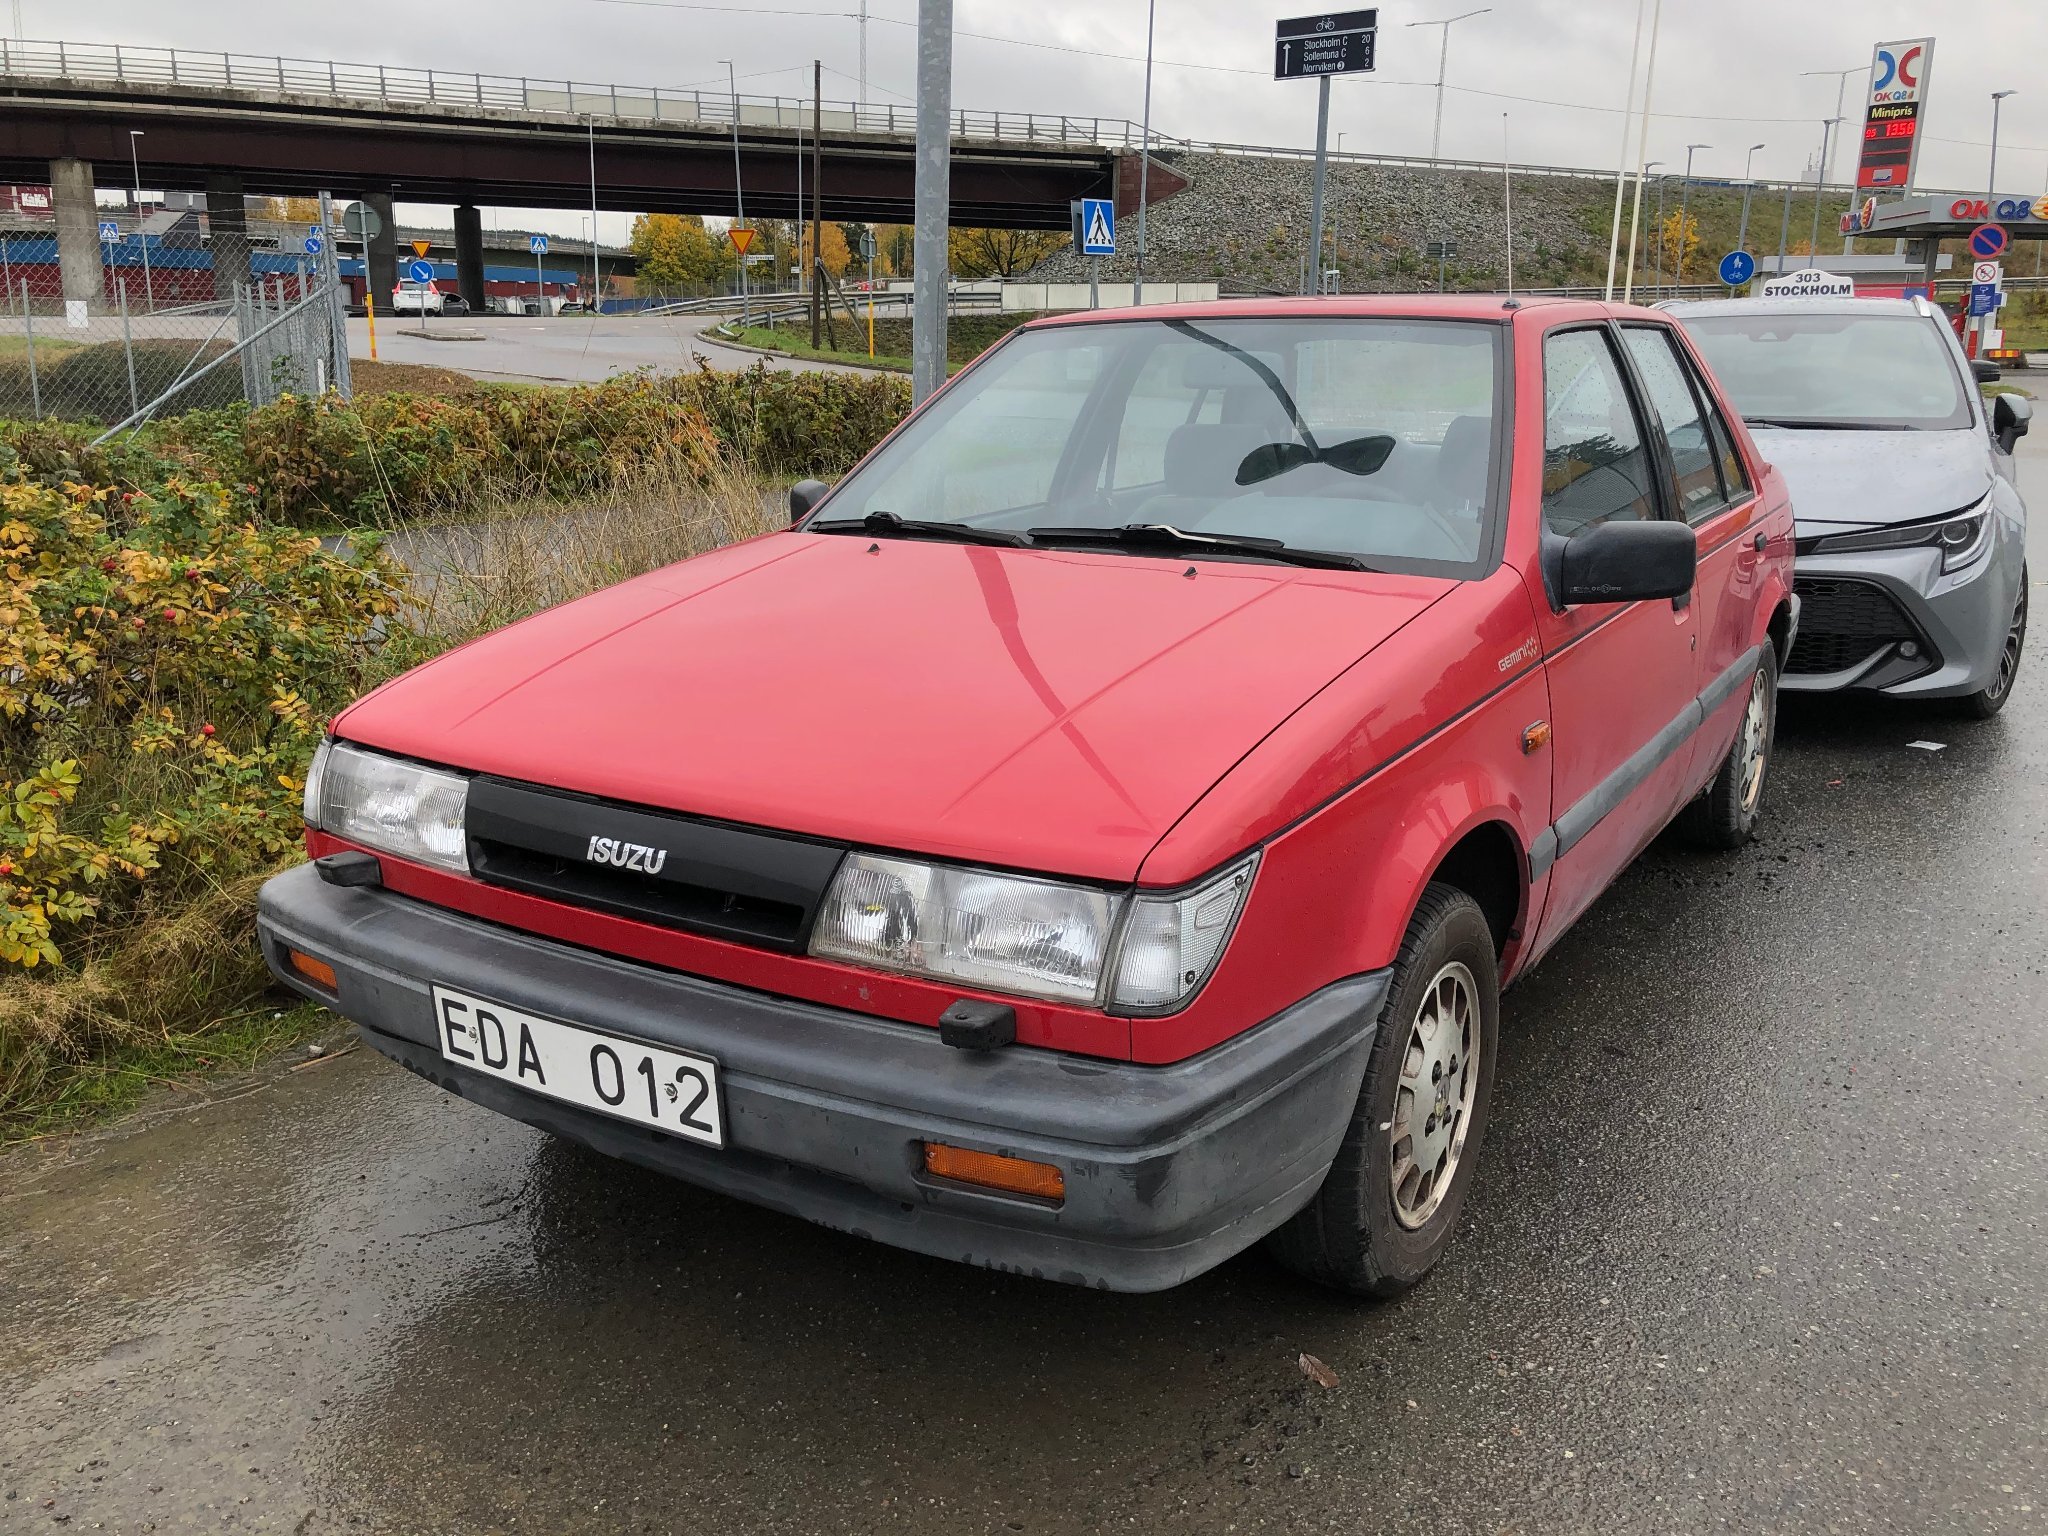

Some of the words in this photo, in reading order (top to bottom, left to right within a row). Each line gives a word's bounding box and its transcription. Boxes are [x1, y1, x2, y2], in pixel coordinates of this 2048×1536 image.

[1304, 38, 1340, 49] Stockholm
[1342, 36, 1347, 45] C
[1361, 34, 1371, 44] 20
[1303, 51, 1339, 61] Sollentuna
[1341, 48, 1346, 57] C
[1365, 46, 1370, 55] 6
[1303, 62, 1335, 72] Norrviken
[1364, 58, 1370, 67] 2
[1874, 91, 1892, 102] OK
[1871, 105, 1913, 119] Minipris
[1951, 199, 1994, 219] OK
[1996, 199, 2031, 219] Q8
[1795, 273, 1821, 283] 303
[1764, 284, 1851, 297] STOCKHOLM
[1498, 645, 1528, 672] GEMINI
[586, 835, 668, 875] ISUZU
[441, 997, 546, 1086] EDA
[590, 1043, 713, 1134] 012
